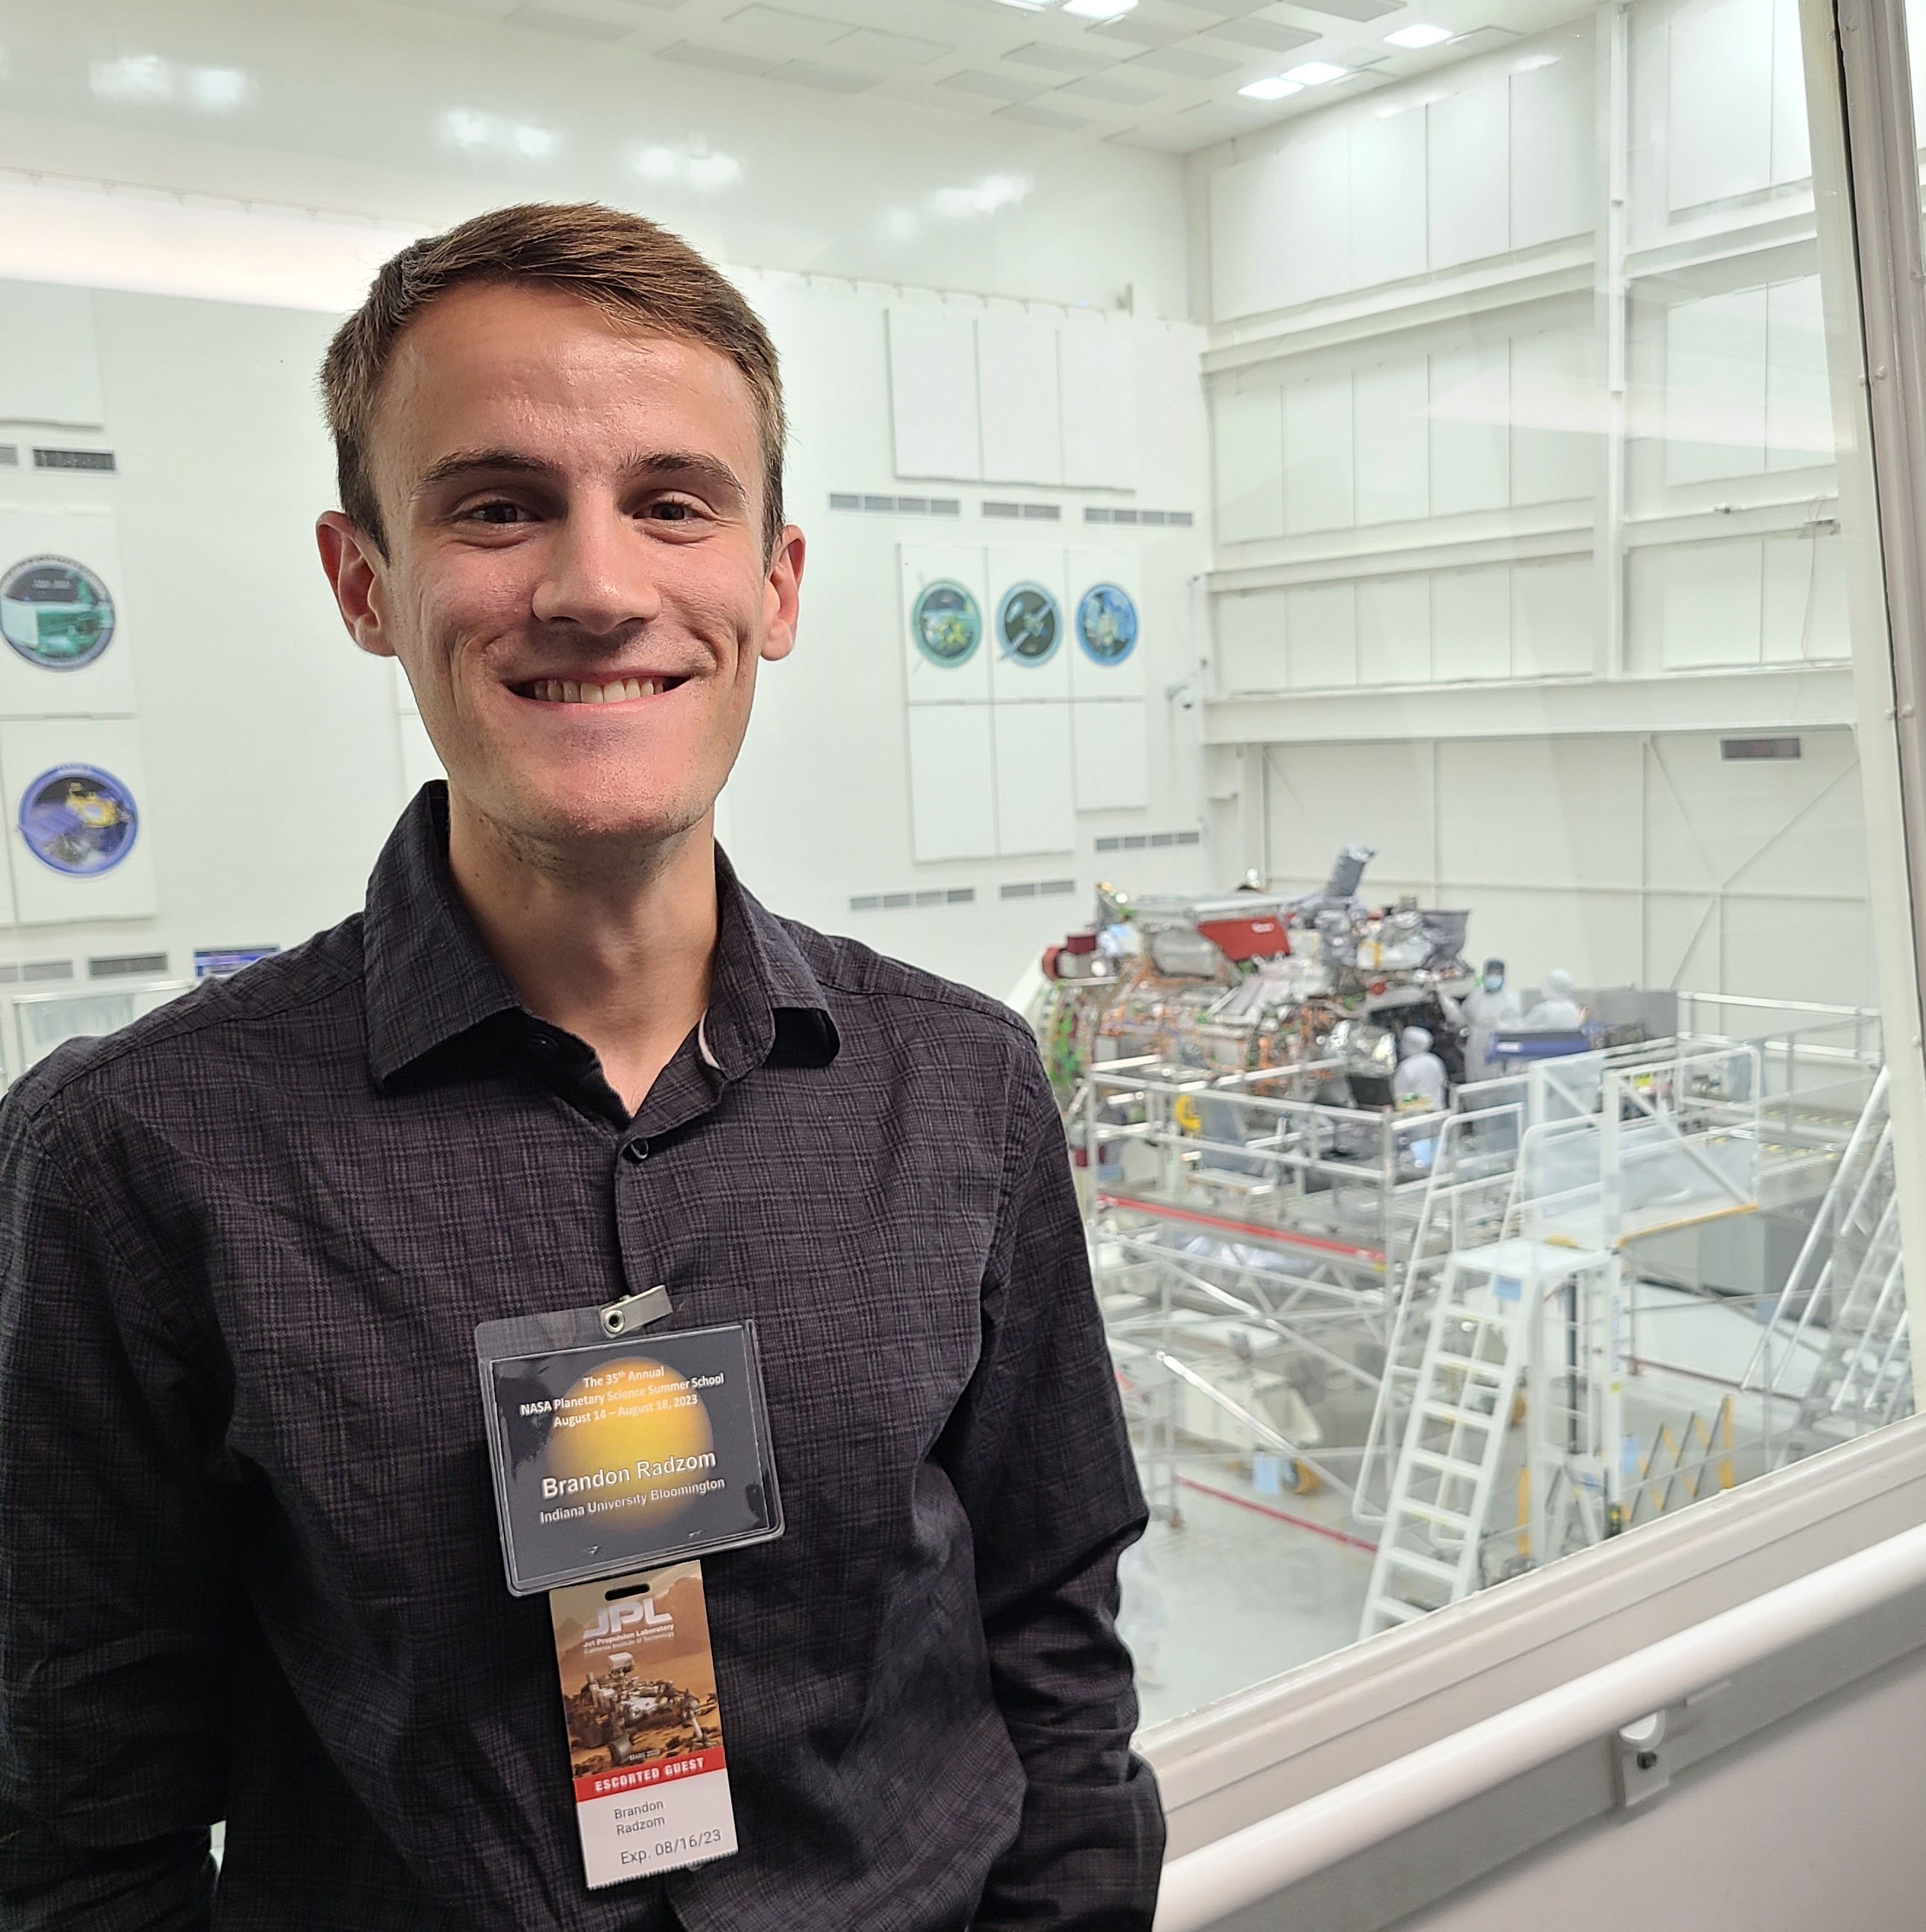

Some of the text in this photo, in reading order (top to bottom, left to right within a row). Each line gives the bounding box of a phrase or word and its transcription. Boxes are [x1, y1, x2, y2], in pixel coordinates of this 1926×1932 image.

[583, 1365, 664, 1388] The 35th Annual
[520, 1373, 724, 1417] NASA Planetary Science Summer School
[554, 1413, 591, 1427] August
[594, 1409, 607, 1421] 14
[618, 1403, 653, 1417] August
[656, 1398, 672, 1411] 18,
[674, 1394, 698, 1408] 2023
[542, 1452, 717, 1500] Brandon Radzom
[540, 1478, 726, 1524] Indiana University Bloomington
[583, 1597, 673, 1639] JPL
[583, 1623, 675, 1647] Jet Propulsion Laboratory
[595, 1757, 704, 1792] ESCORTED GUEST
[614, 1800, 664, 1820] Brandon
[616, 1816, 666, 1836] Radzom
[621, 1828, 721, 1865] Exp. 08/16/23
